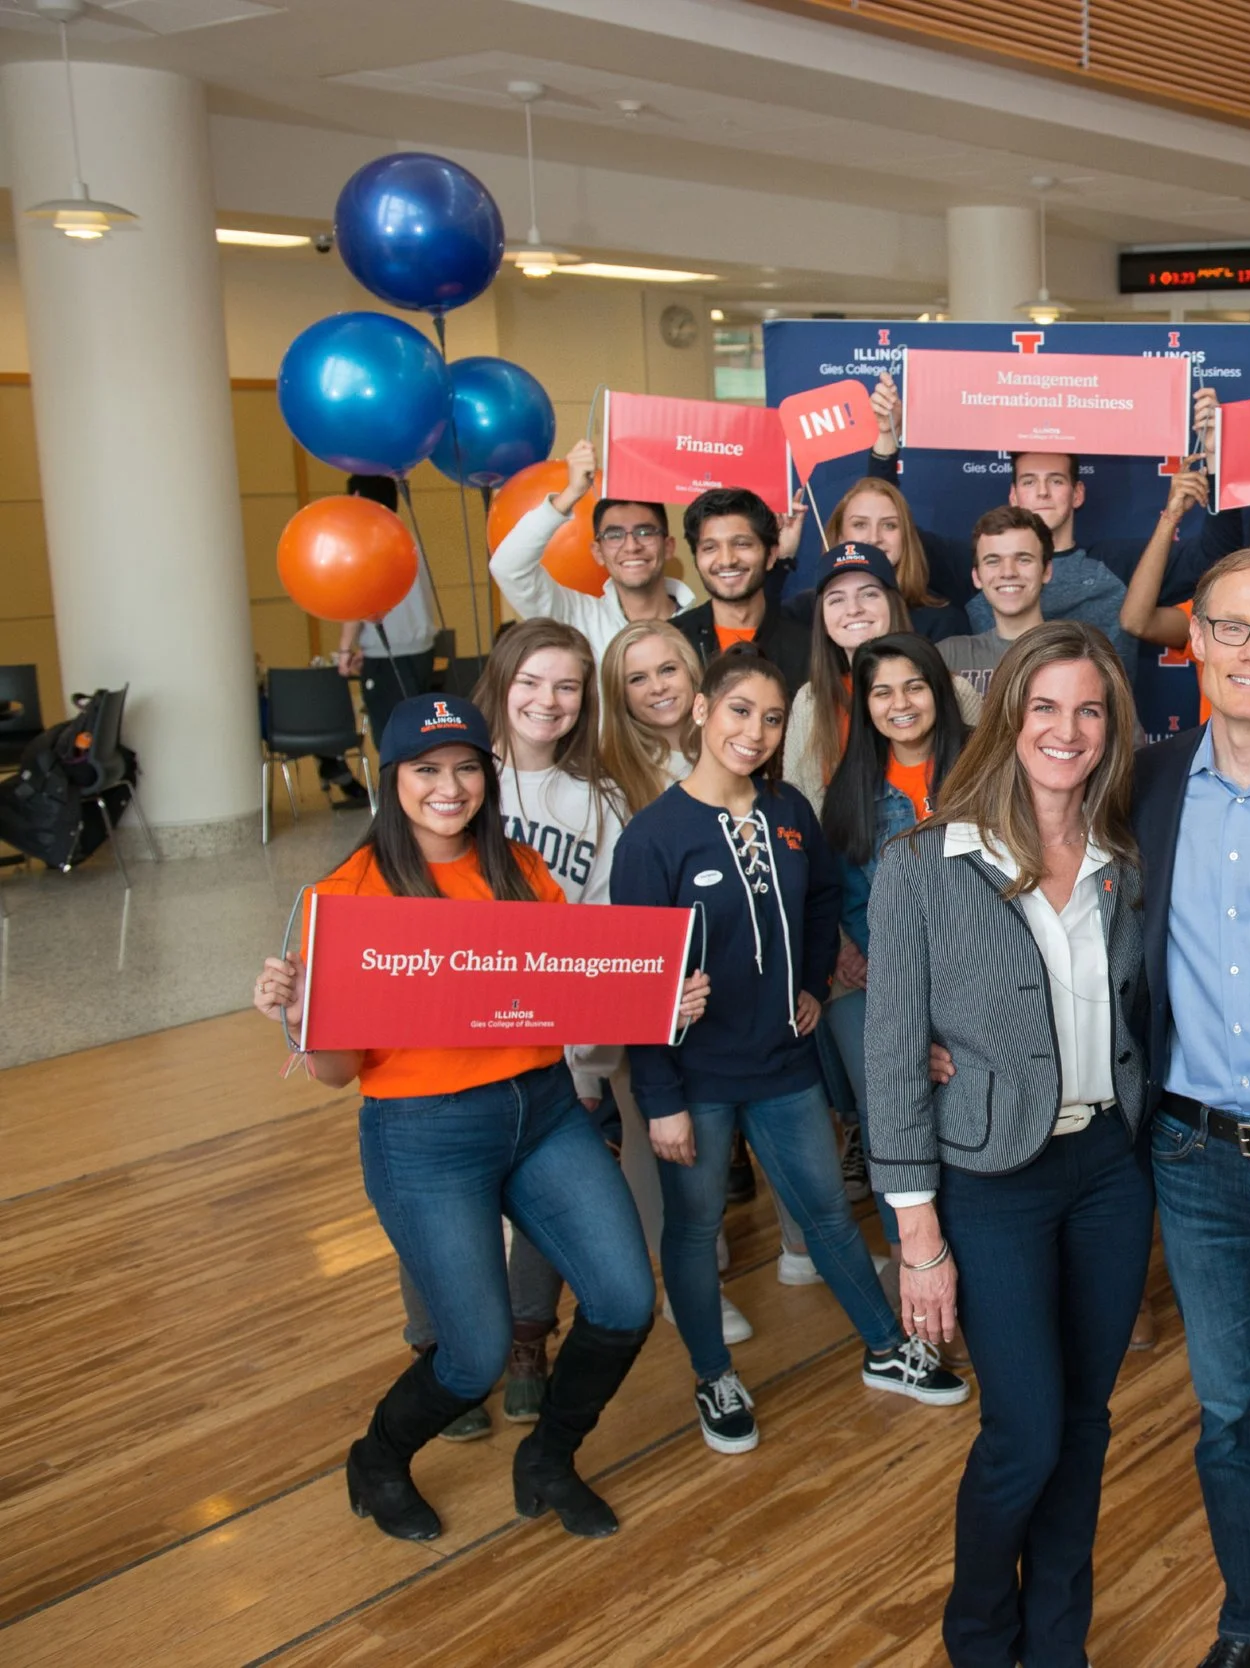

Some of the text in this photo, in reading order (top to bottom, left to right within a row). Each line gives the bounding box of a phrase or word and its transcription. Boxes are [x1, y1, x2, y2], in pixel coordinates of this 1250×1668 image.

[853, 348, 906, 361] ILLINO
[819, 363, 844, 376] Gies
[889, 363, 901, 375] of
[1192, 366, 1242, 378] Business
[997, 370, 1099, 389] Management
[960, 391, 1134, 411] International Business
[799, 402, 856, 440] INI!
[675, 434, 744, 457] Finance
[962, 462, 1012, 474] Gies Coll
[424, 716, 462, 726] ILLINOIS
[361, 948, 665, 978] Supply Chain Management
[494, 1009, 535, 1020] ILLINOIS
[470, 1020, 555, 1029] Gies College of Business
